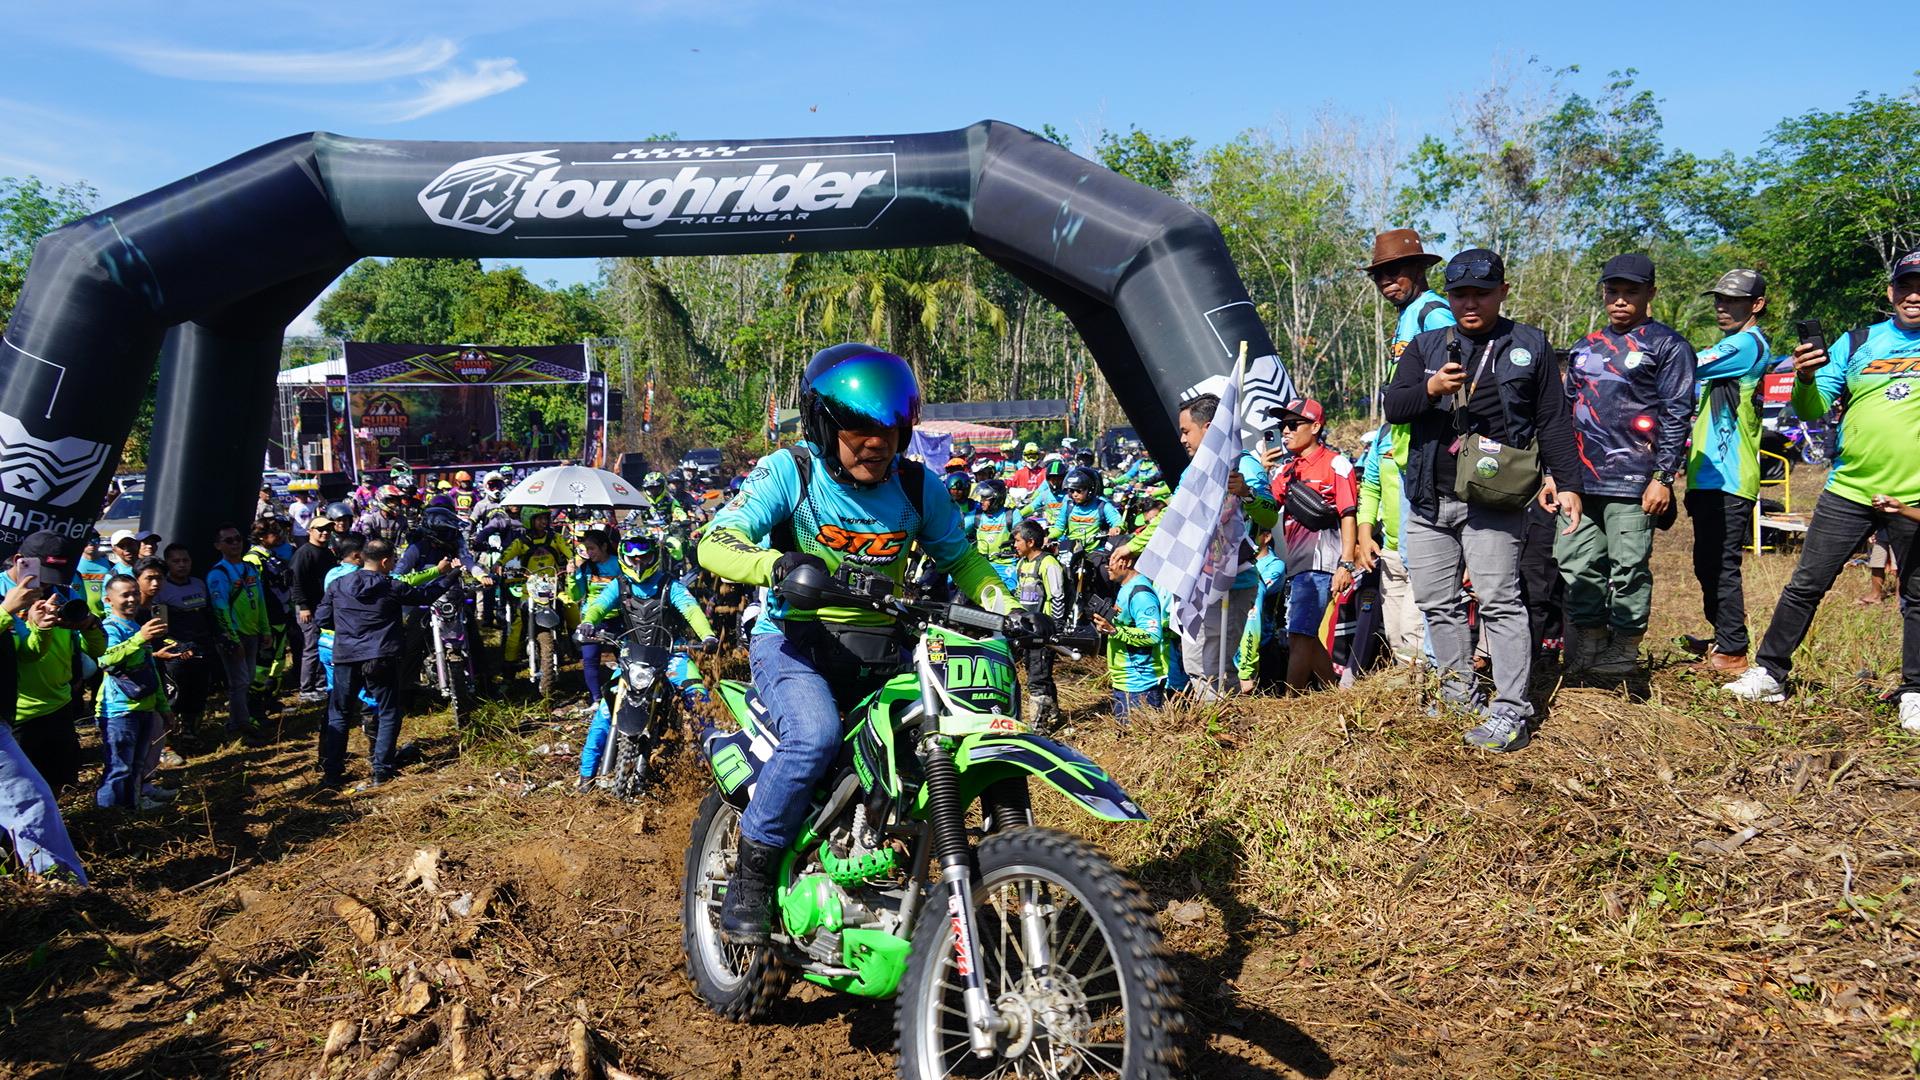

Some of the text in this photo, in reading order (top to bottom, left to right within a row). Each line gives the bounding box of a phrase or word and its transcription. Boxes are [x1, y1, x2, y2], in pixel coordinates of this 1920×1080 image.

[515, 162, 887, 229] toughrider
[680, 212, 810, 225] RACEWEAR
[815, 524, 908, 557] STC
